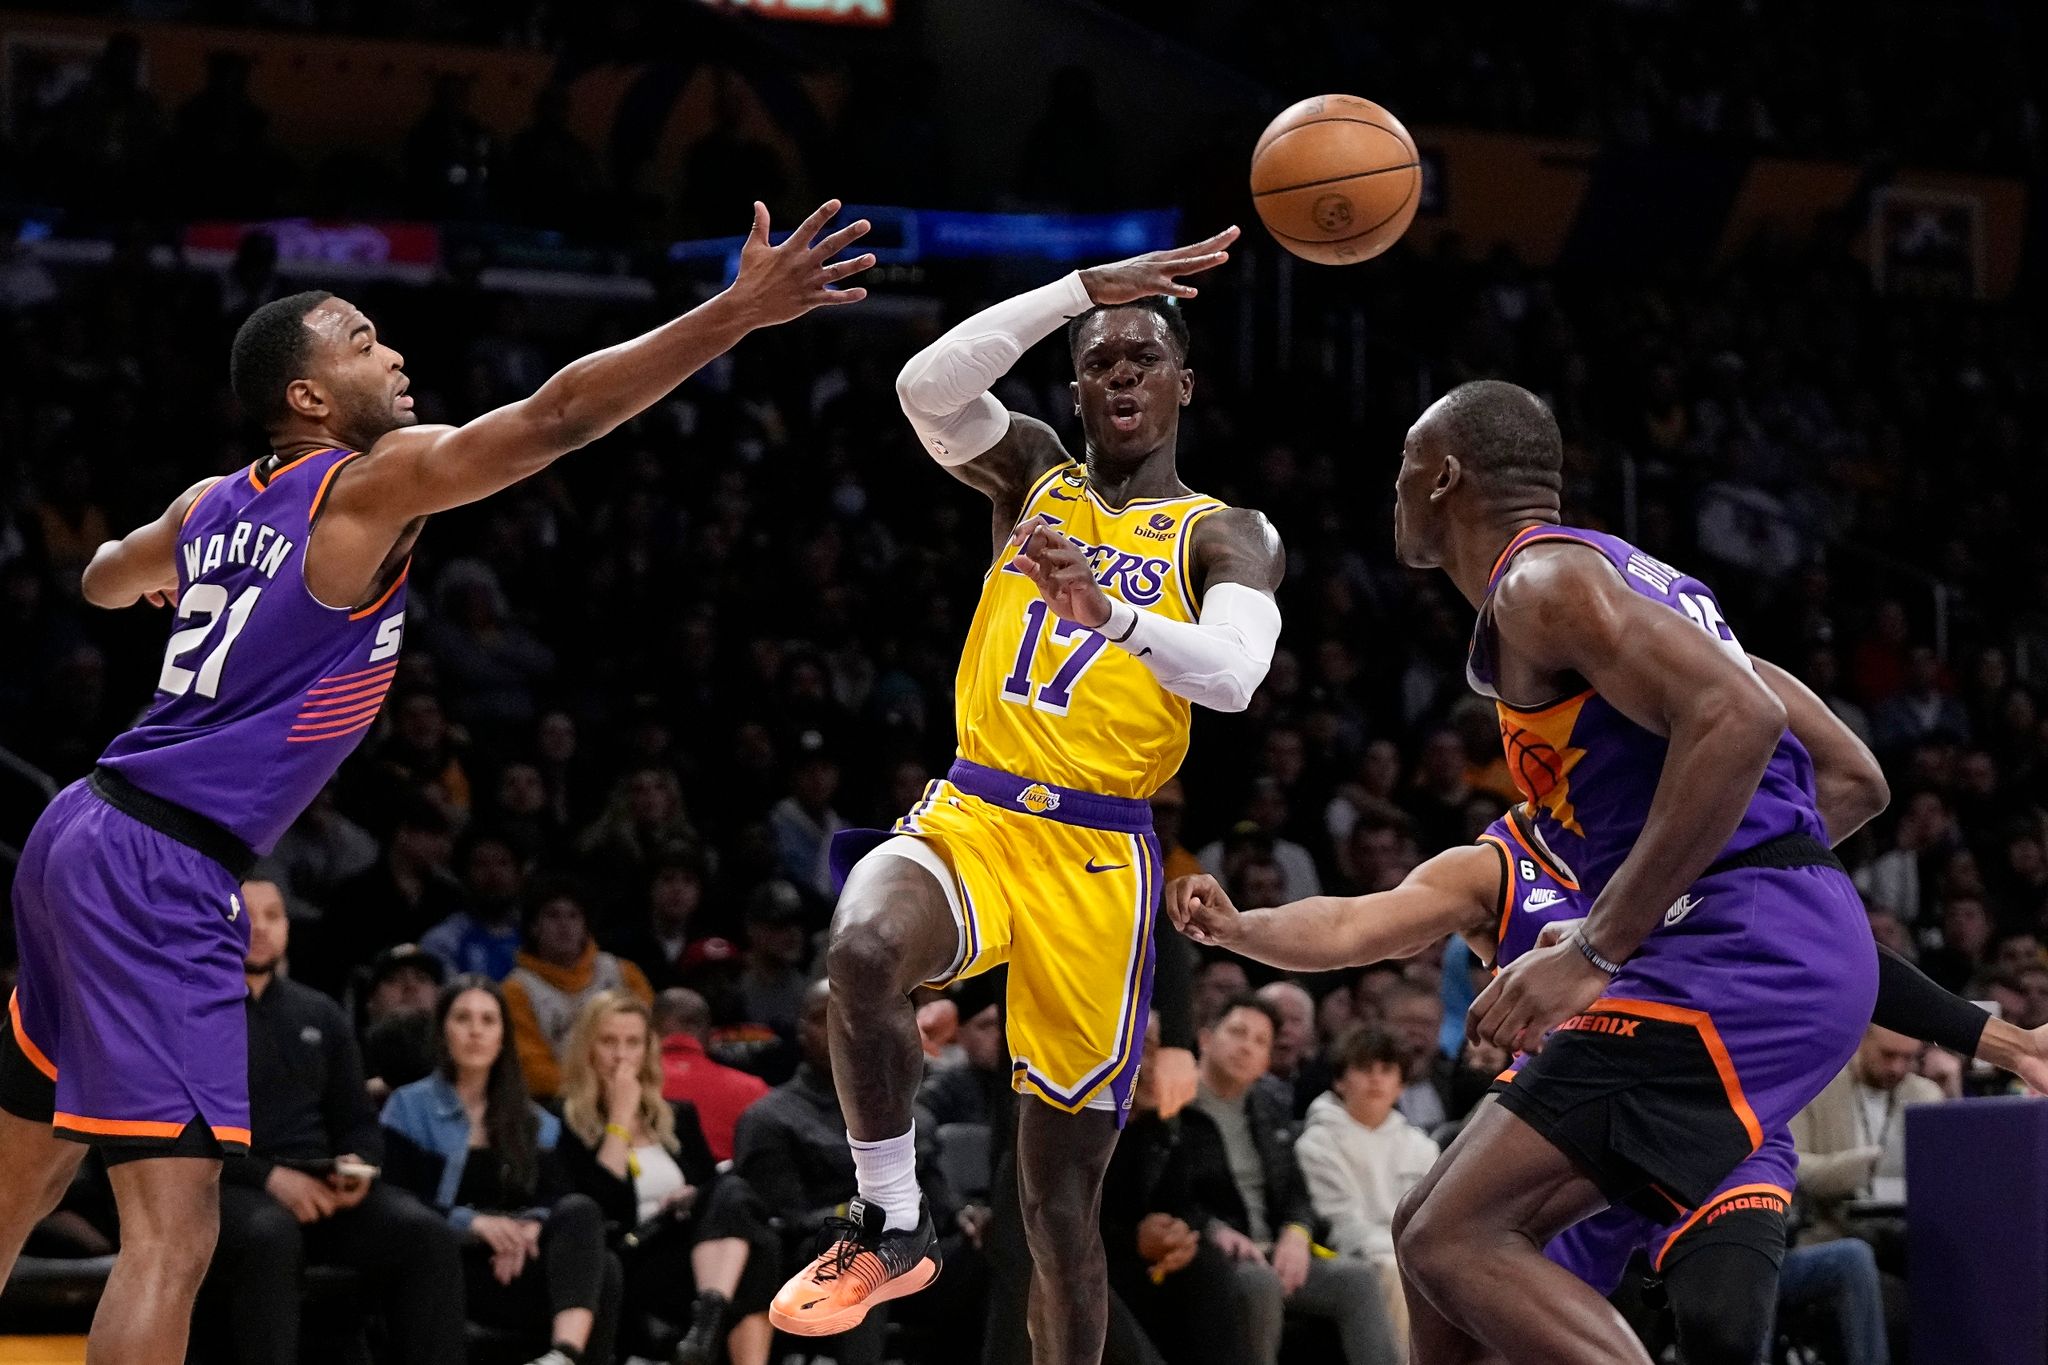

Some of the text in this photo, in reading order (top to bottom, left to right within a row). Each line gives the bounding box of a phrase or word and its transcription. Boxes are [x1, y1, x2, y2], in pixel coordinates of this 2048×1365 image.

[1133, 526, 1177, 542] bibigo
[158, 583, 262, 699] 21
[1000, 600, 1108, 718] 17
[1016, 784, 1061, 811] LAKERS
[1519, 859, 1536, 881] 6
[1529, 887, 1557, 903] NIKE
[1666, 893, 1691, 920] NIKE
[1552, 1014, 1642, 1037] OENIX
